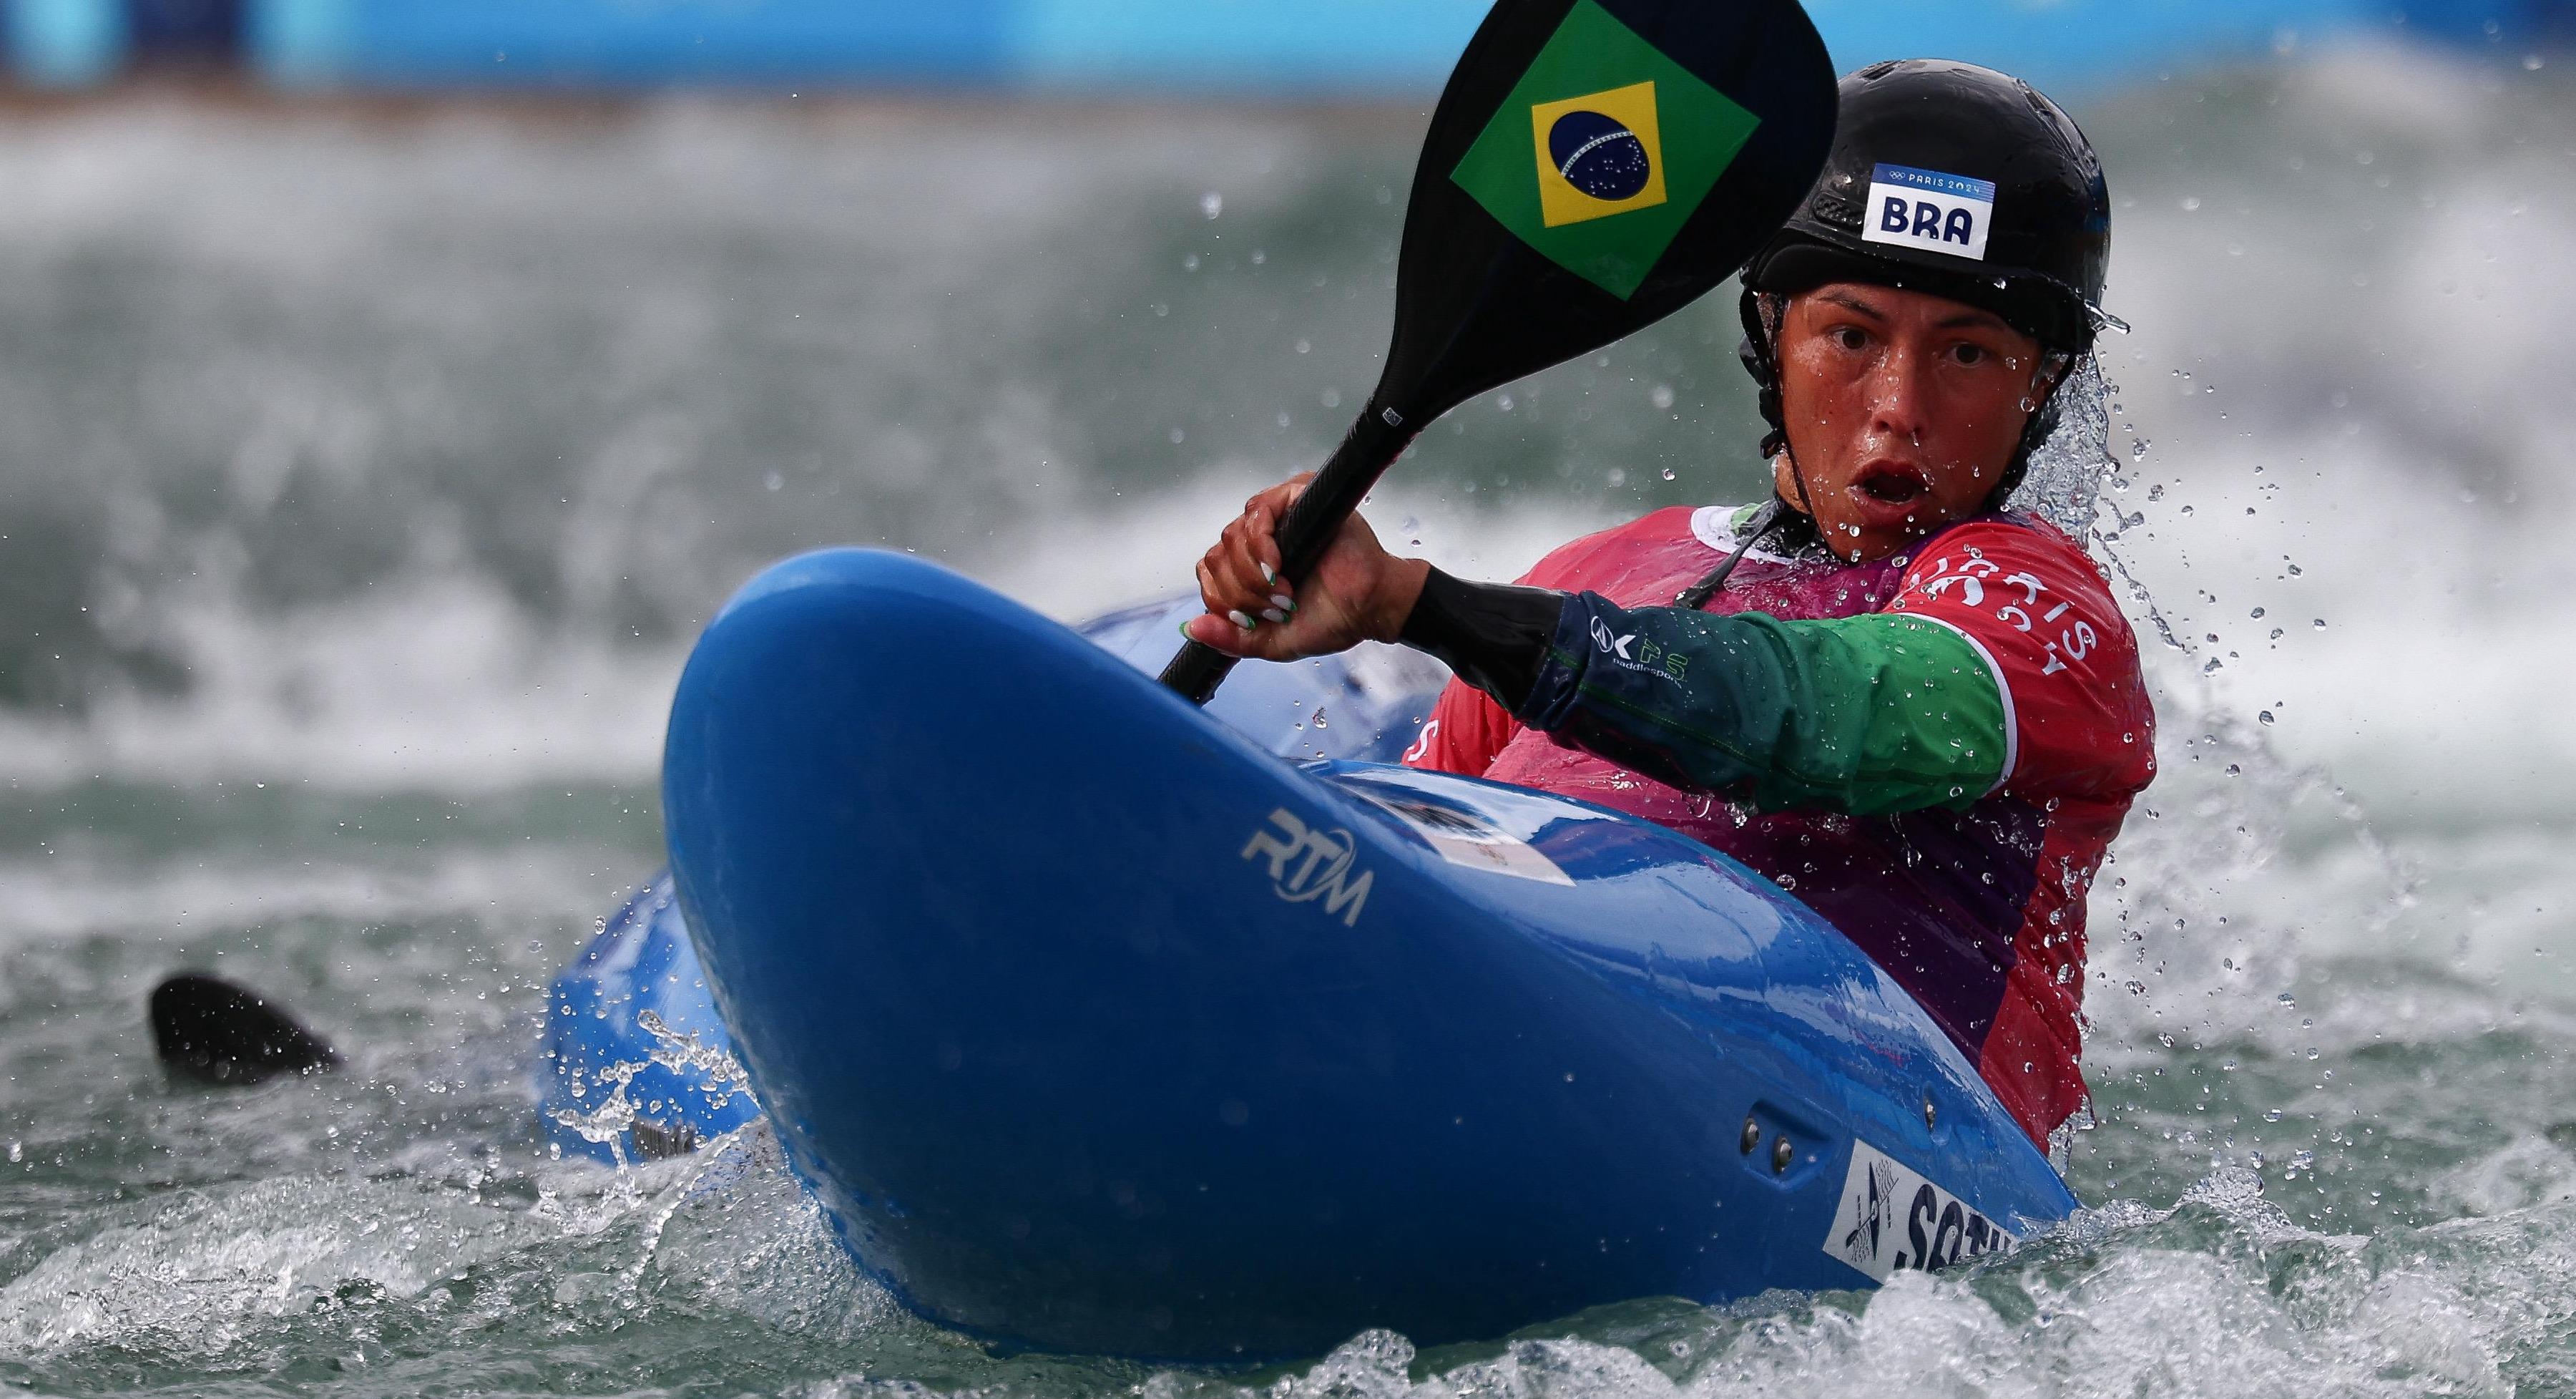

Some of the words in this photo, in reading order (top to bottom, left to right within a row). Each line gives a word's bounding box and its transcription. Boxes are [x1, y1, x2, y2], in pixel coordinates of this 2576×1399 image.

[1909, 173, 1944, 187] PARIS
[1948, 180, 1980, 193] 2024
[1881, 196, 1973, 246] BRA
[1241, 807, 1374, 928] RTM
